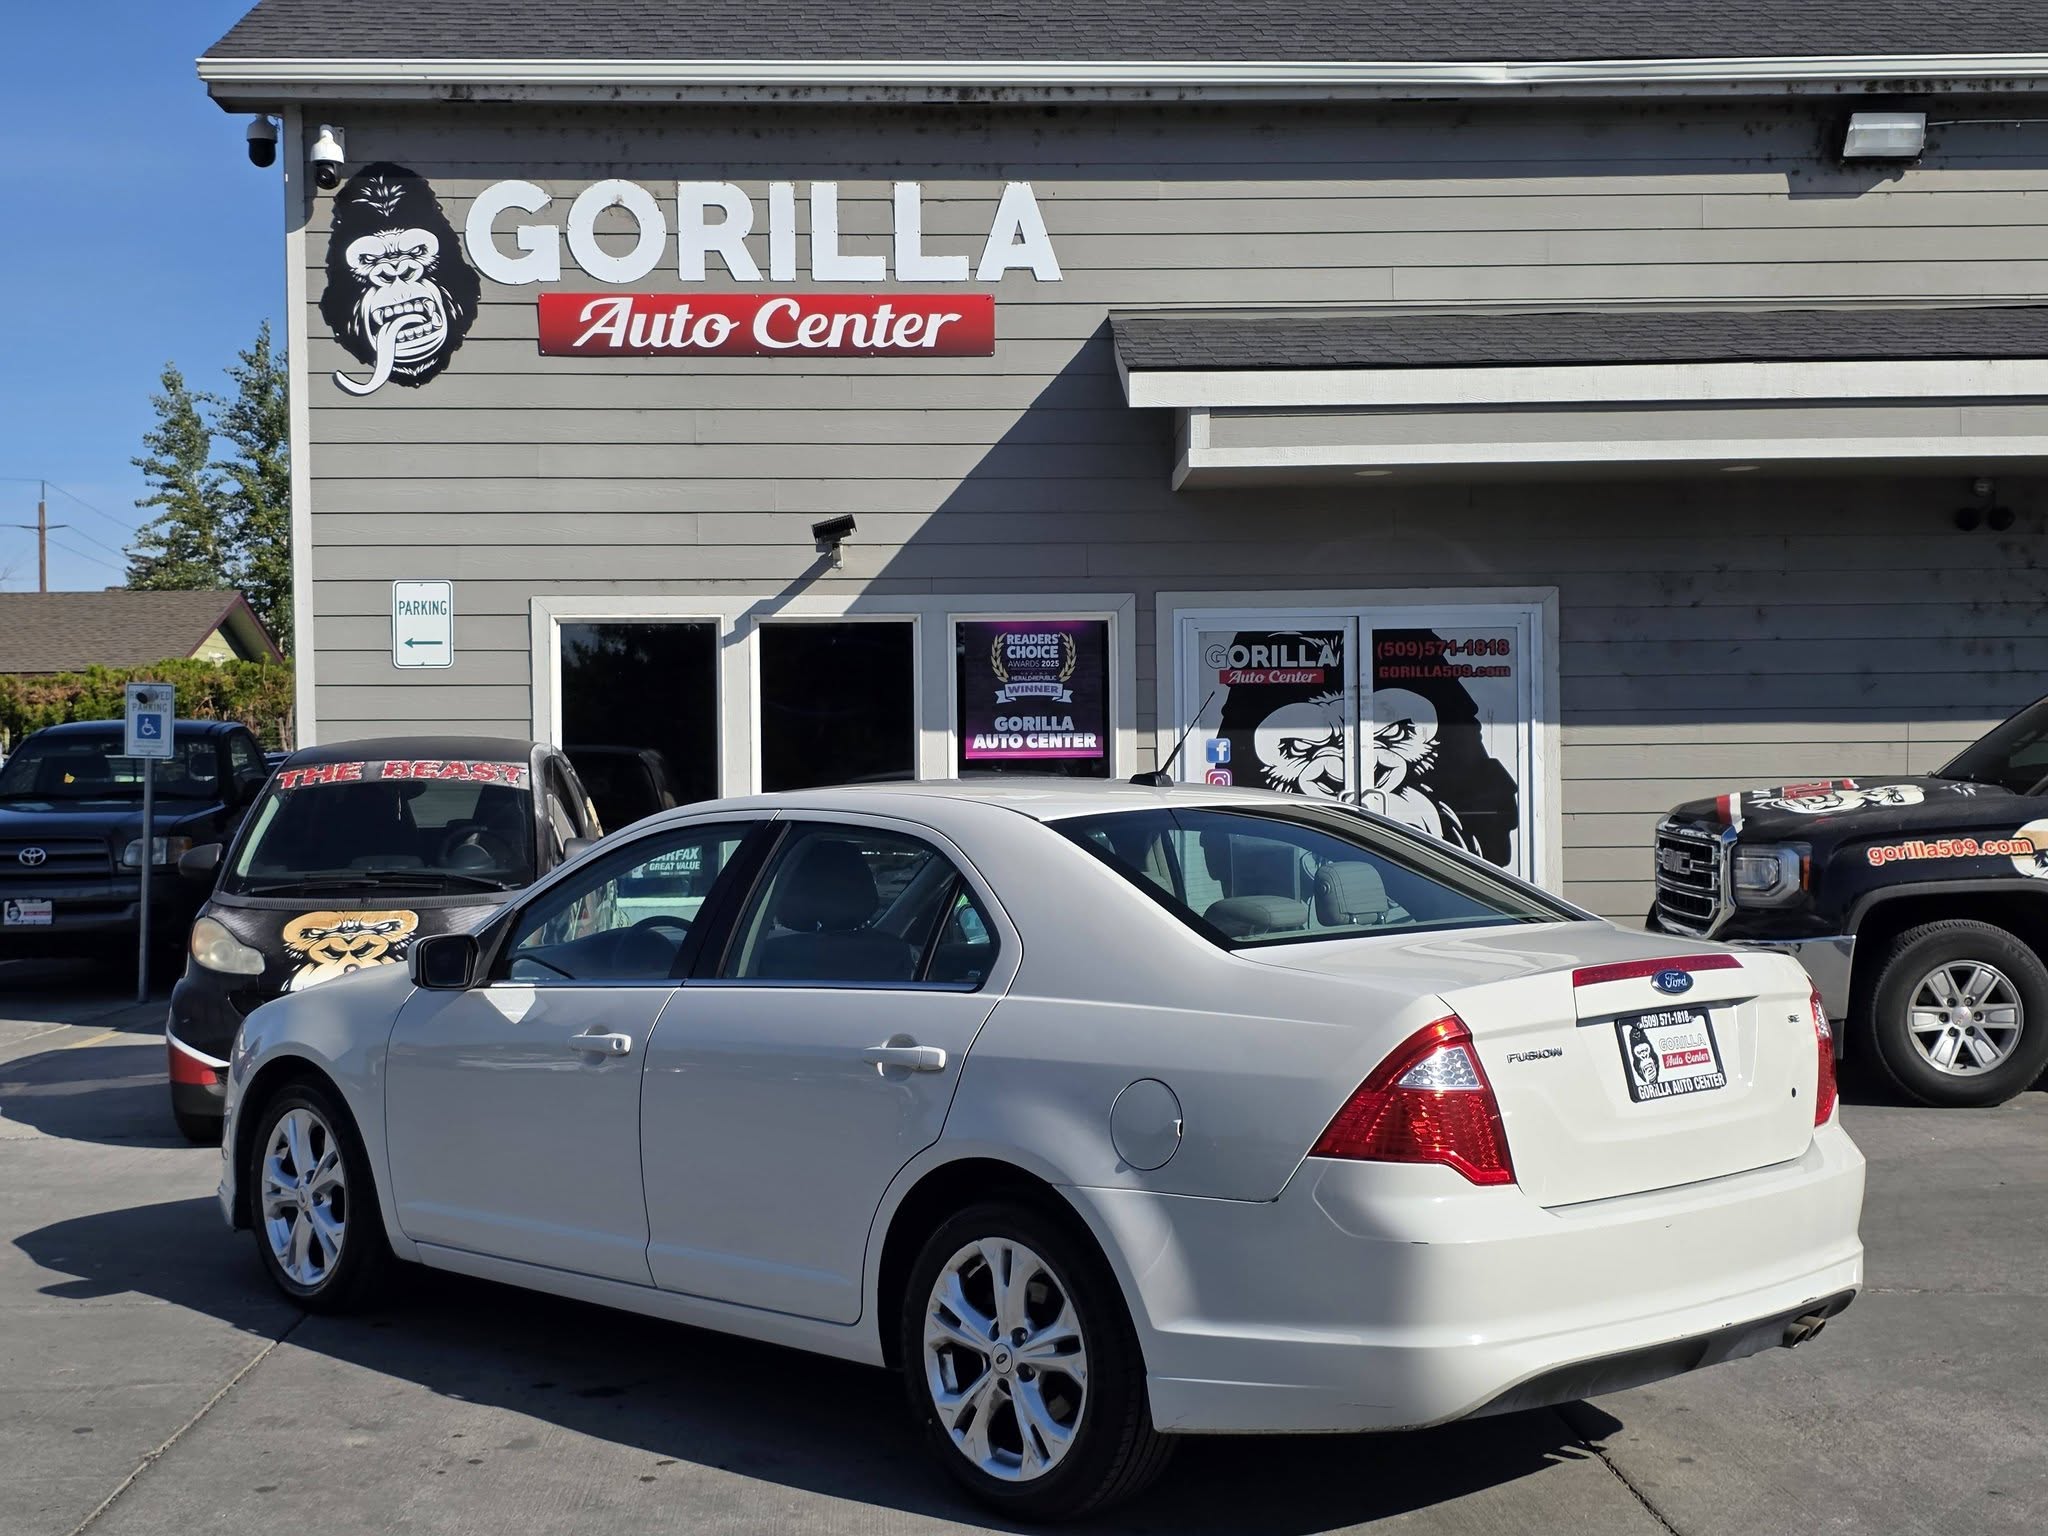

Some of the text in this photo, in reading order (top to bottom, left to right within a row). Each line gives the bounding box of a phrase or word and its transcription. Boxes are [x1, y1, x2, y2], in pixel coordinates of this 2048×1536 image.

[464, 179, 1064, 284] GORILLA
[573, 297, 962, 349] Auto Center
[398, 599, 448, 616] PARKING
[1006, 646, 1059, 659] CHOICE
[1204, 643, 1338, 670] GORILLA
[1377, 639, 1510, 659] (509)571-1818
[1227, 670, 1317, 683] Auto Center
[1379, 664, 1511, 678] GORILLA509.com
[1007, 685, 1059, 694] WINNER
[131, 703, 168, 713] PARKING
[994, 716, 1075, 732] GORILLA
[972, 733, 1097, 749] AUTO CENTER
[276, 760, 529, 790] THE BEAST
[650, 847, 700, 862] ARFAX
[1662, 847, 1691, 875] GMC
[1868, 838, 2033, 867] gorilla509.com
[649, 861, 701, 871] GREAT VALUE
[1664, 972, 1688, 988] Ford
[1641, 1010, 1690, 1028] (509) 571-1818
[1658, 1033, 1707, 1052] GORILLA
[1506, 1046, 1563, 1064] FUSION
[1665, 1051, 1709, 1067] Auto Center
[1638, 1072, 1725, 1100] GORILLA AUTO CENTER
